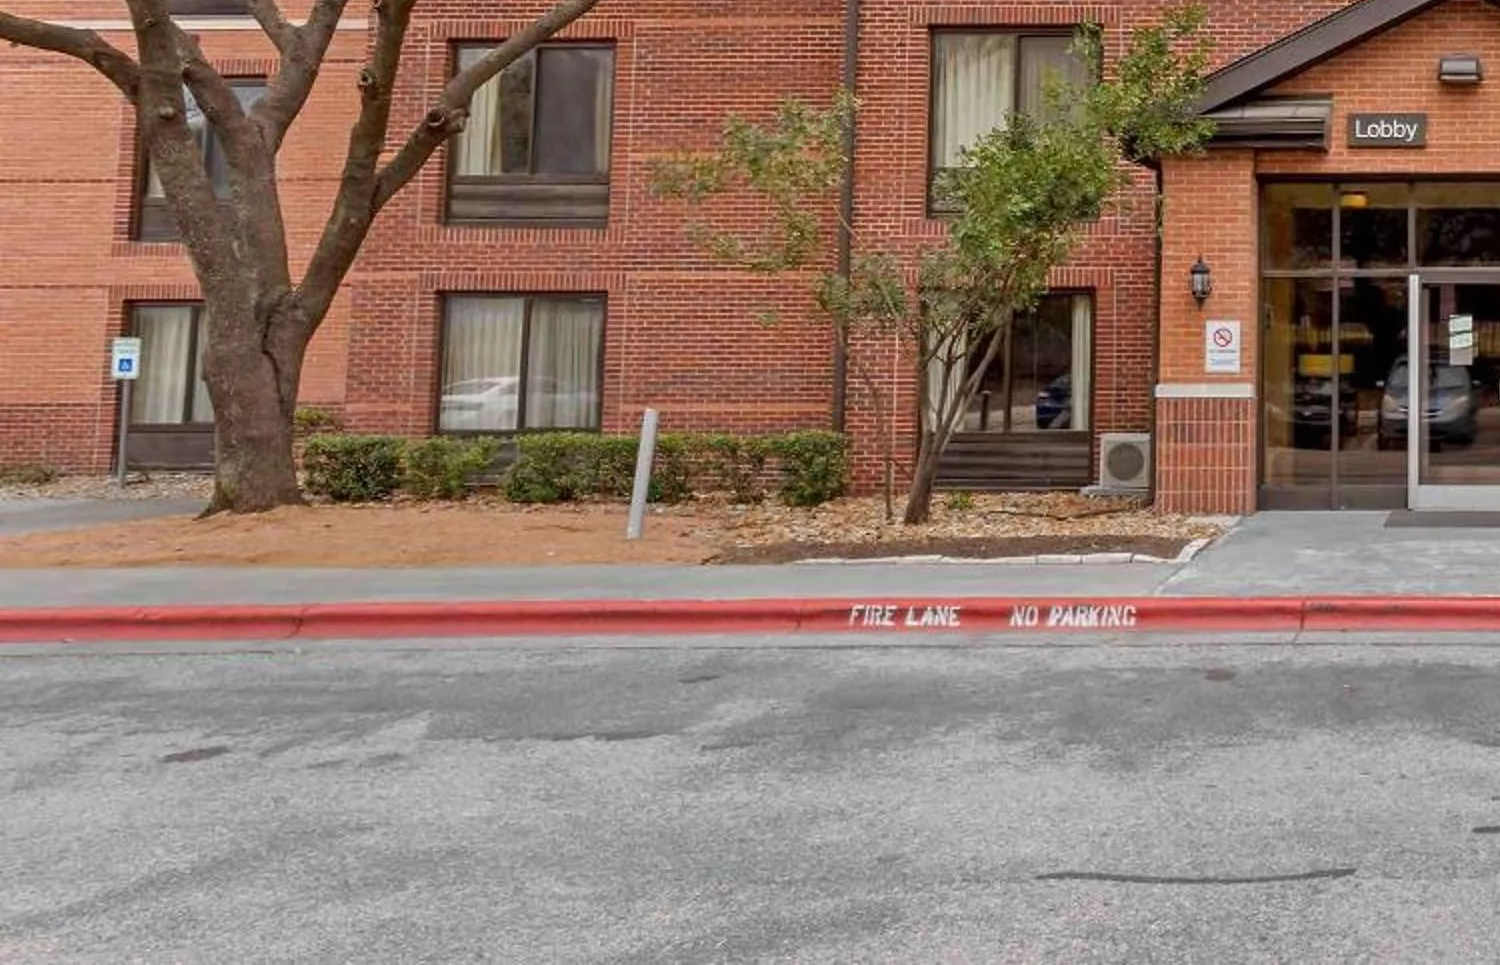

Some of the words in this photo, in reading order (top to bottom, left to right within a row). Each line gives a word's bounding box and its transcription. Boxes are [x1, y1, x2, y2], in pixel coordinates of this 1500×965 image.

[1354, 119, 1418, 142] Lobby
[849, 604, 898, 627] FIRE
[904, 605, 962, 627] LANE
[1008, 604, 1040, 627] NO
[1046, 604, 1137, 627] PARKING
